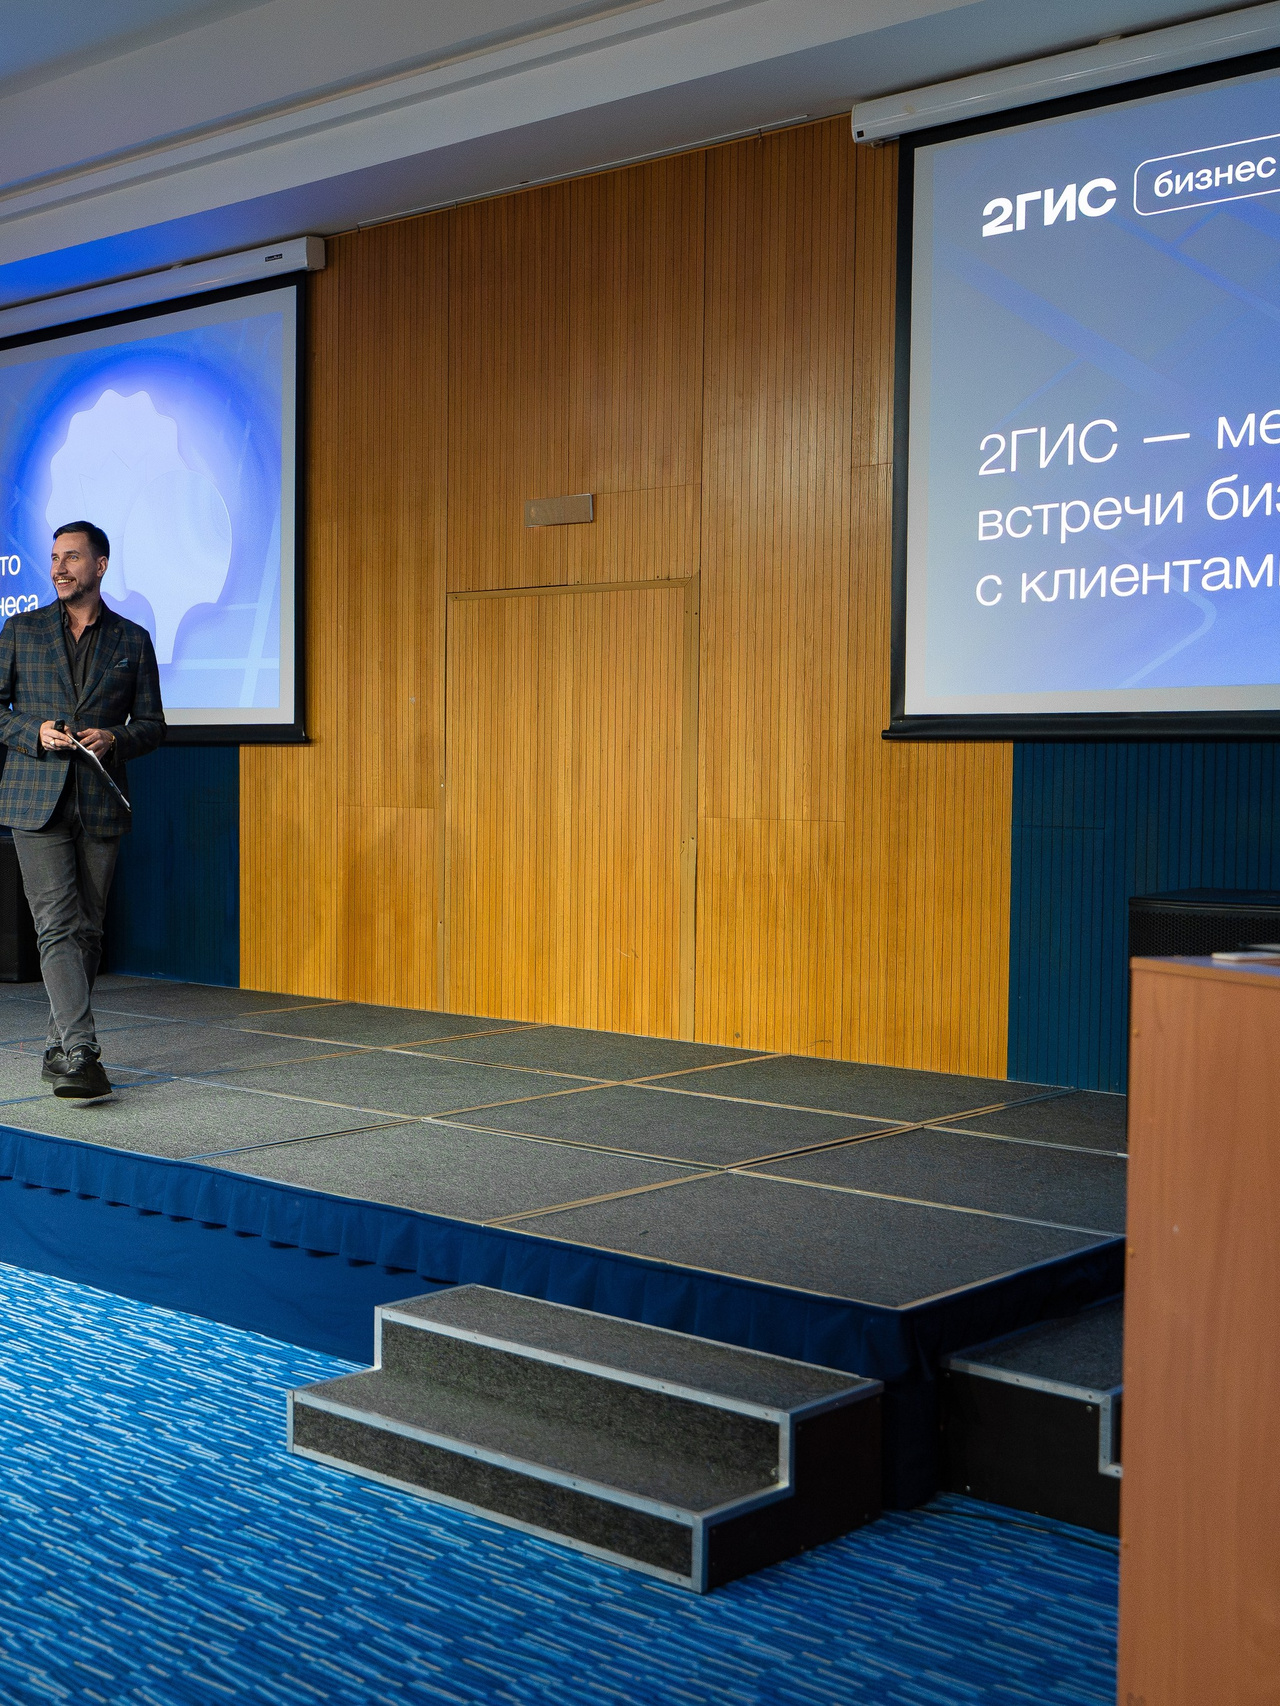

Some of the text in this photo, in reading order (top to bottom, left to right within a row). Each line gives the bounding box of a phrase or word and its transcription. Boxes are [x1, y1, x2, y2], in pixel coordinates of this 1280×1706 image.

[982, 156, 1277, 238] 2ГИС бизнес
[978, 419, 1118, 476] 2ГИС
[978, 473, 1280, 544] встречи би
[975, 552, 1280, 607] с клиентам
